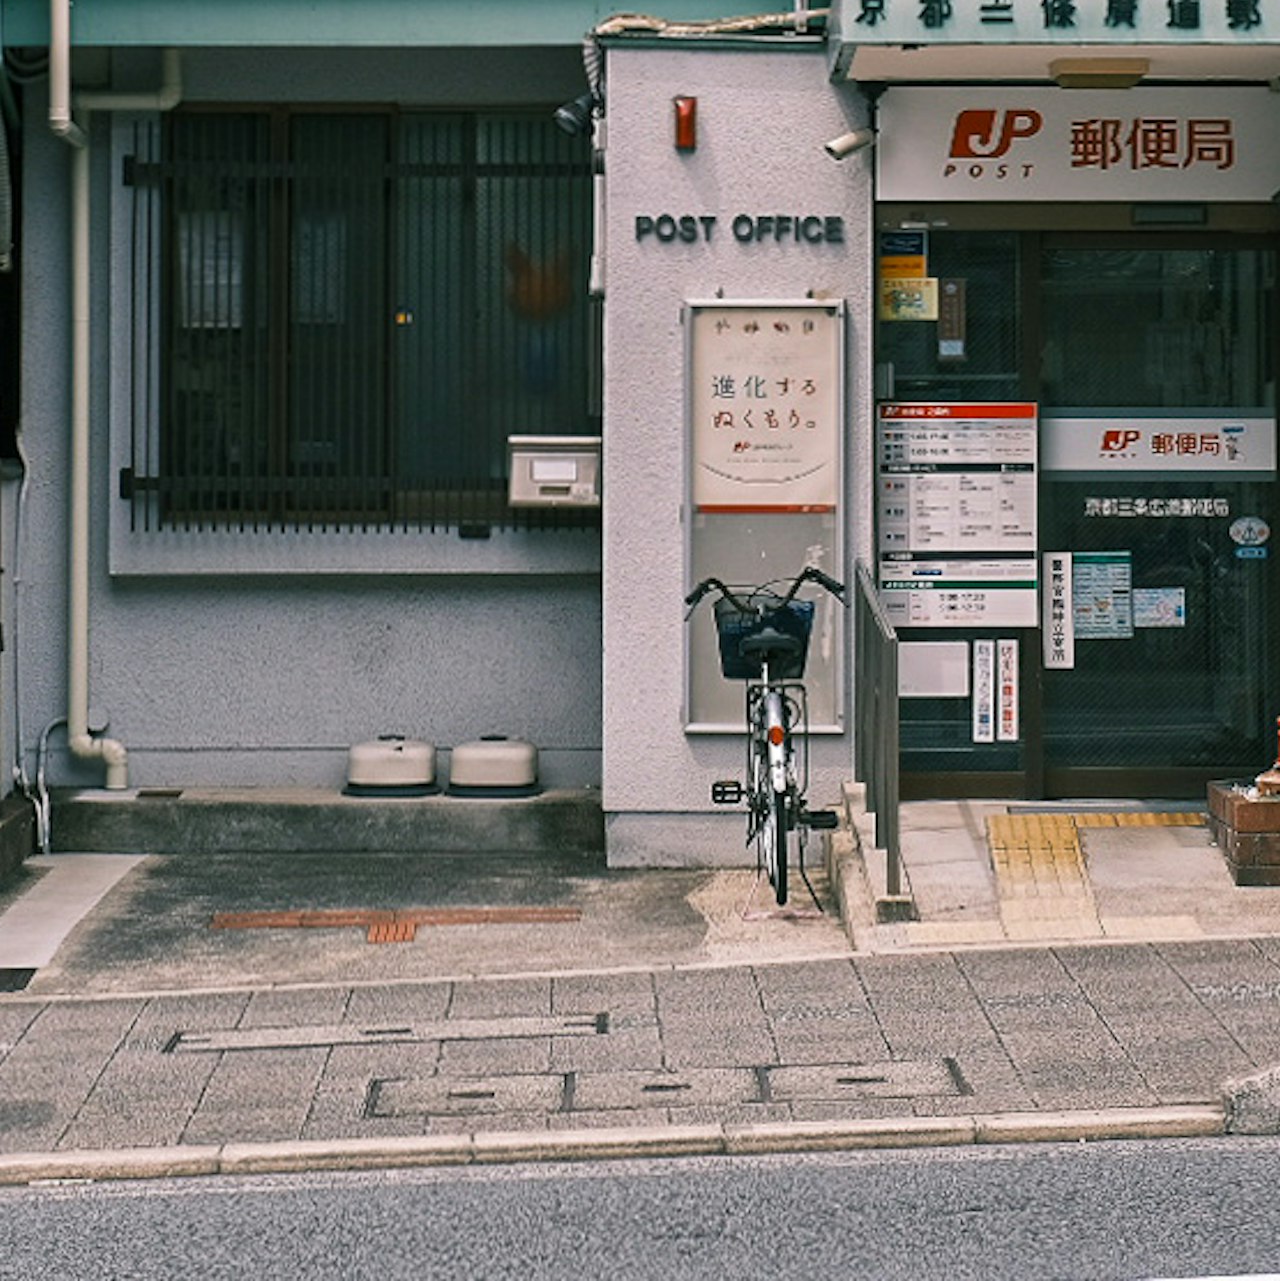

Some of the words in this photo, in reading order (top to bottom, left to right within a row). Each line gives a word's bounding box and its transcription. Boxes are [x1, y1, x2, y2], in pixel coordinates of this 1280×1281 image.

[1069, 117, 1235, 170] 郵便局
[943, 163, 1035, 178] POST
[634, 214, 717, 243] POST
[732, 214, 845, 243] OFFICE
[711, 375, 817, 400] 進化する
[1151, 433, 1220, 456] 郵便局
